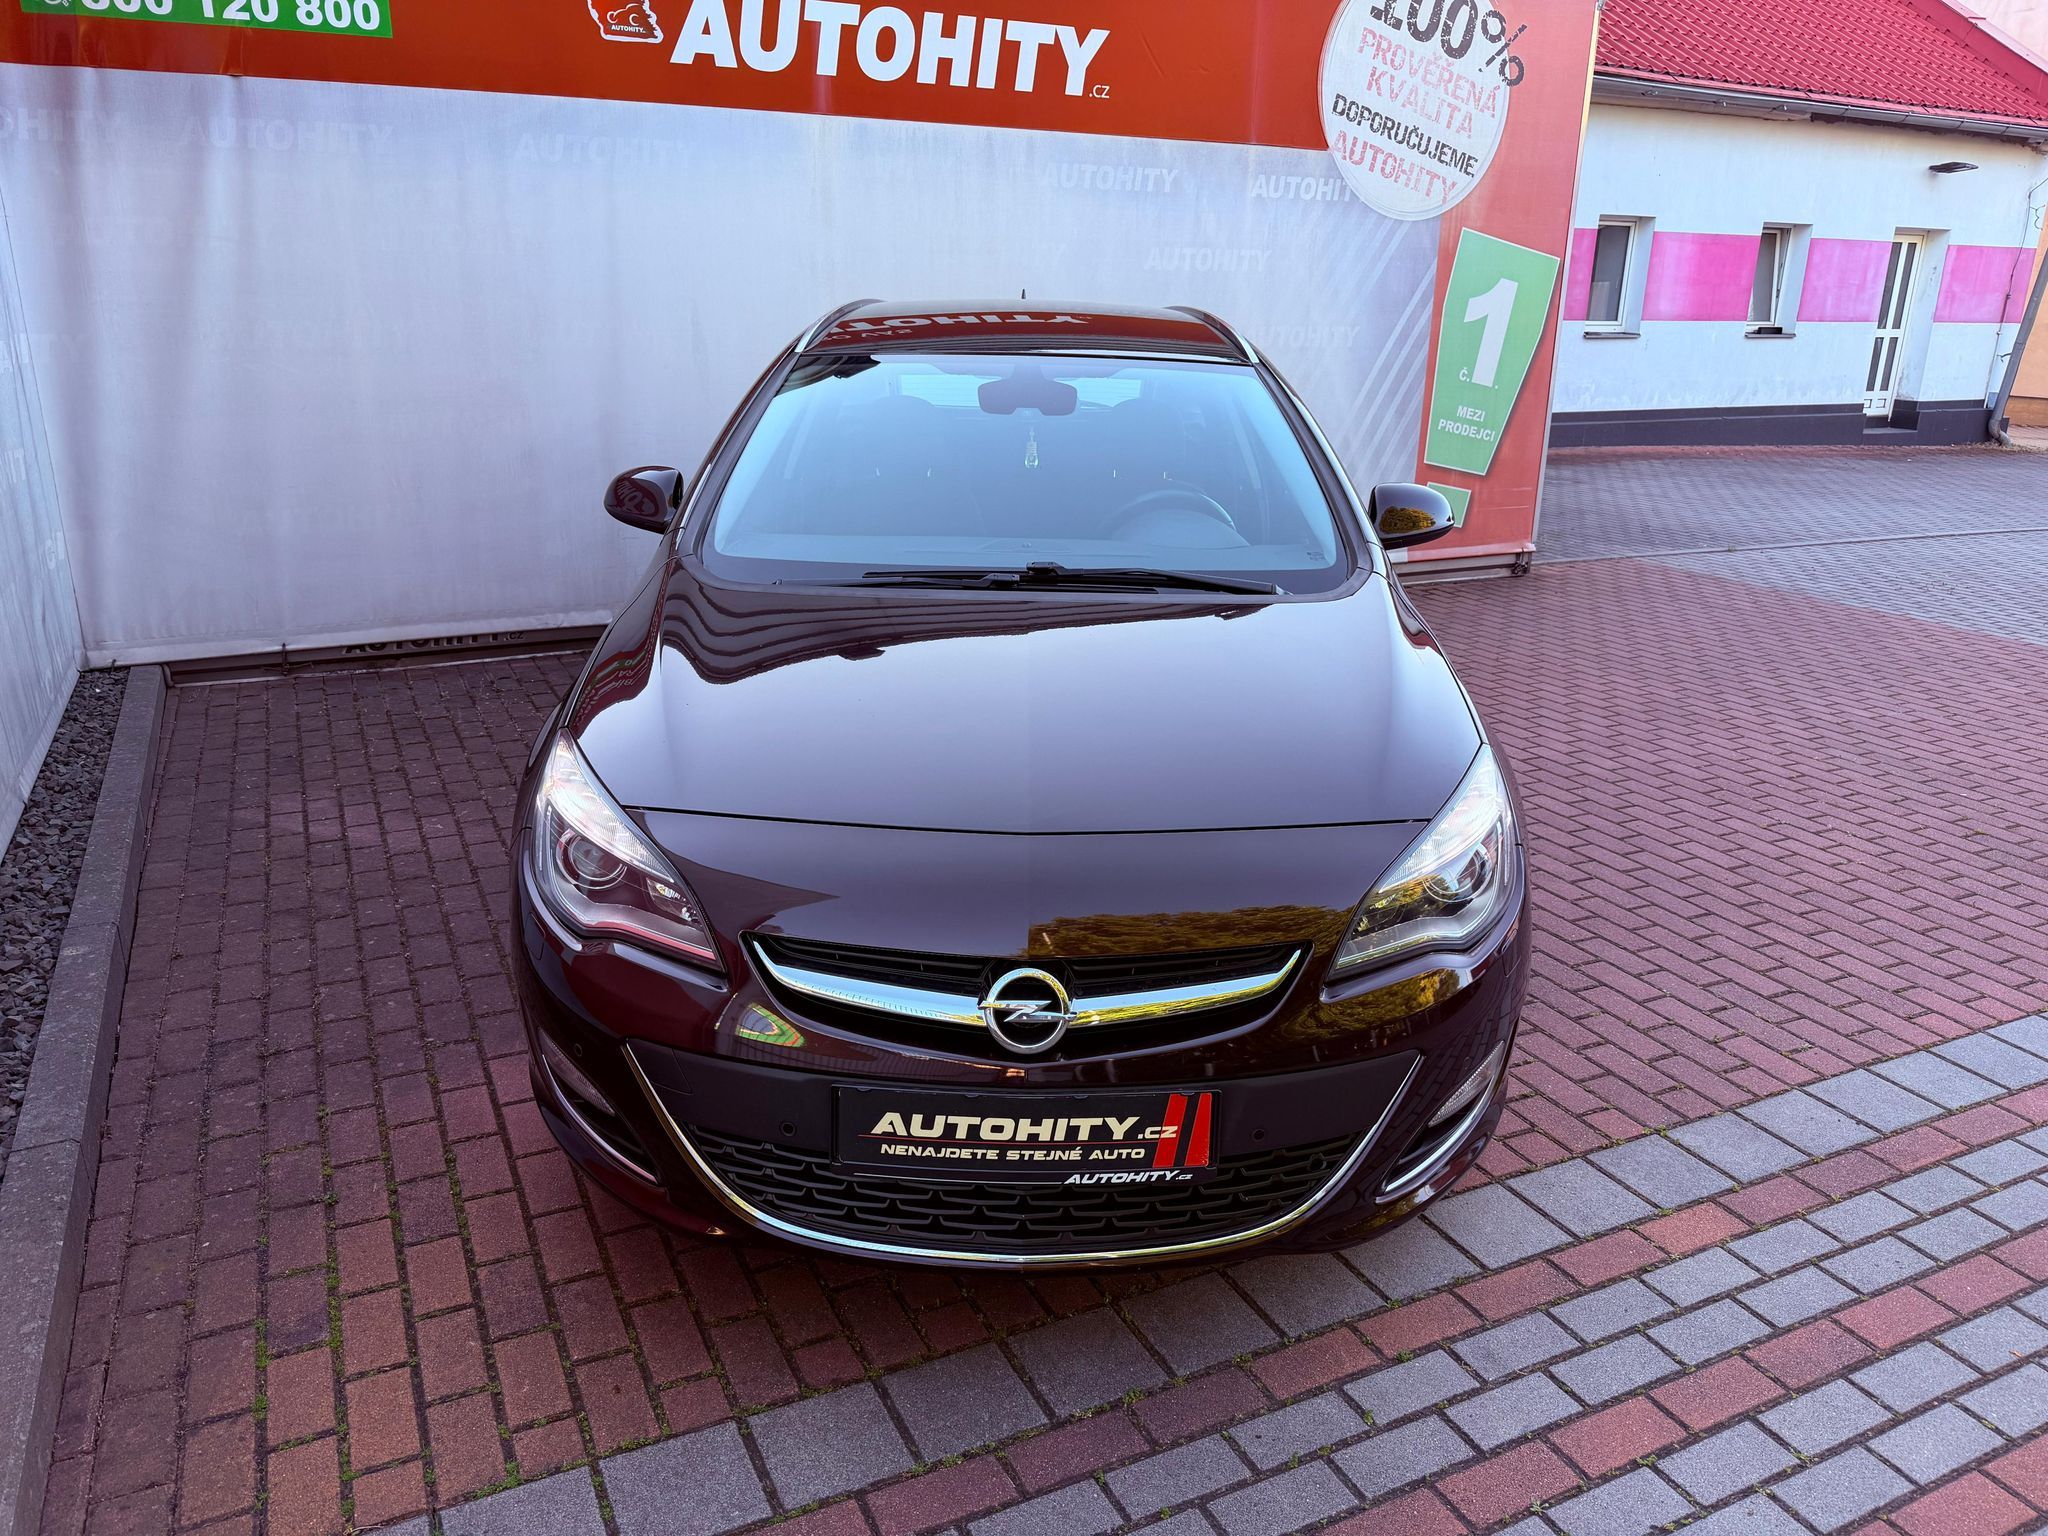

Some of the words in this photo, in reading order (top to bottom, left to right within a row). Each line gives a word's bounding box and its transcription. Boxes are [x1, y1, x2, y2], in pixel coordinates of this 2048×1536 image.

[296, 0, 380, 30] 800
[1358, 26, 1501, 119] PROVĚŘENÁ
[1366, 66, 1474, 139] KVALITA
[1331, 93, 1479, 178] DOPORUČUJEME
[1044, 162, 1180, 193] AUTOHITY
[1331, 130, 1458, 206] AUTOHITY
[1250, 174, 1360, 201] AUTOHIT
[1144, 246, 1273, 272] AUTOHITY
[1456, 405, 1486, 423] MEZI
[1437, 418, 1496, 442] PRODEJCI
[880, 1143, 1000, 1160] NENAJDETE
[1006, 1146, 1082, 1161] STEJNÉ
[1088, 1148, 1146, 1160] AUTO
